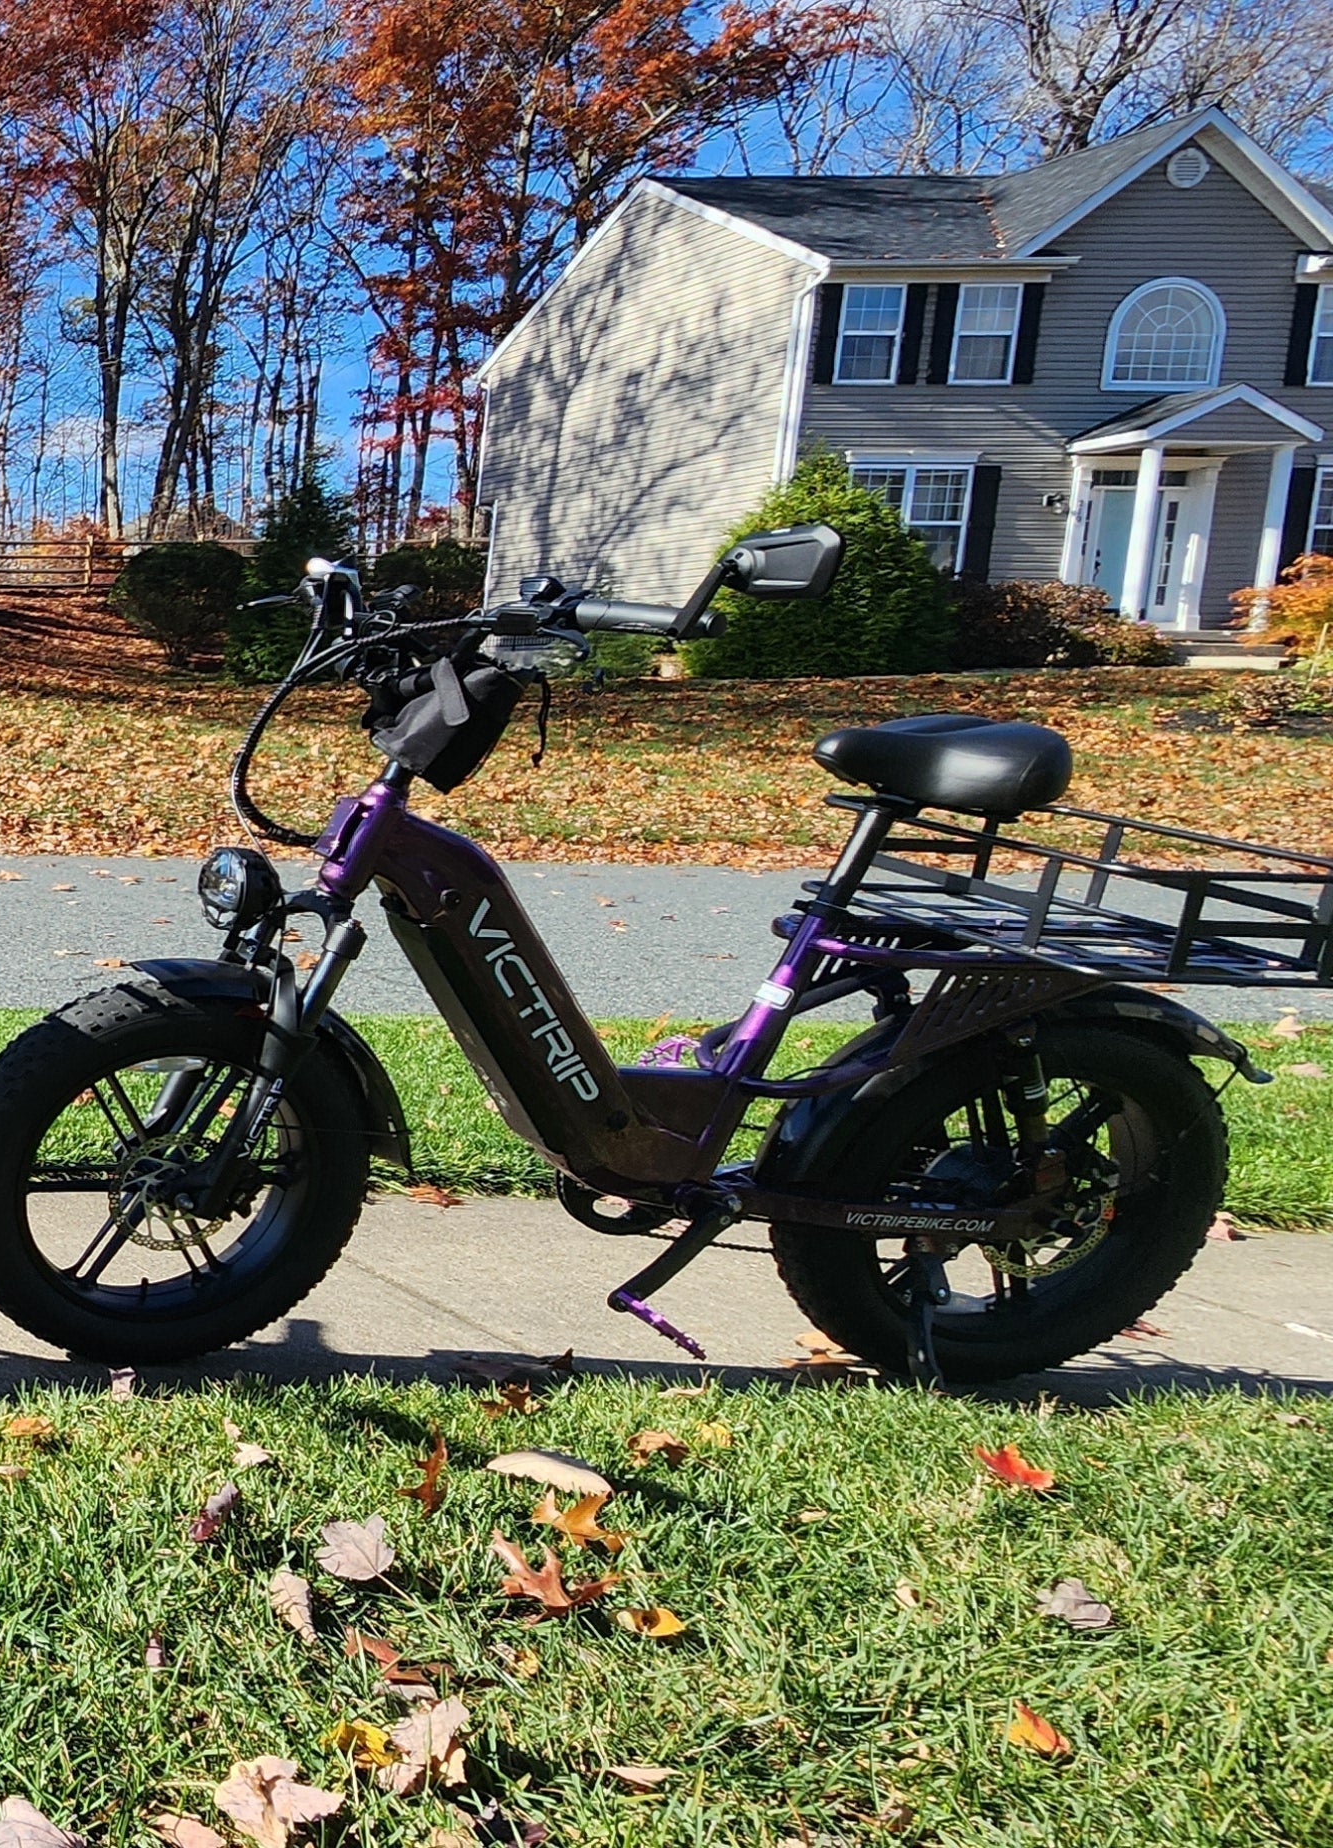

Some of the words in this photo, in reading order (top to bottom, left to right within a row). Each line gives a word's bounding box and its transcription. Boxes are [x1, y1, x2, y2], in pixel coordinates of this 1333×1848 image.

[469, 897, 600, 1102] VICTRIP
[236, 1078, 283, 1159] VICTRP
[845, 1212, 996, 1232] VICTRIPEBIKE.COM
